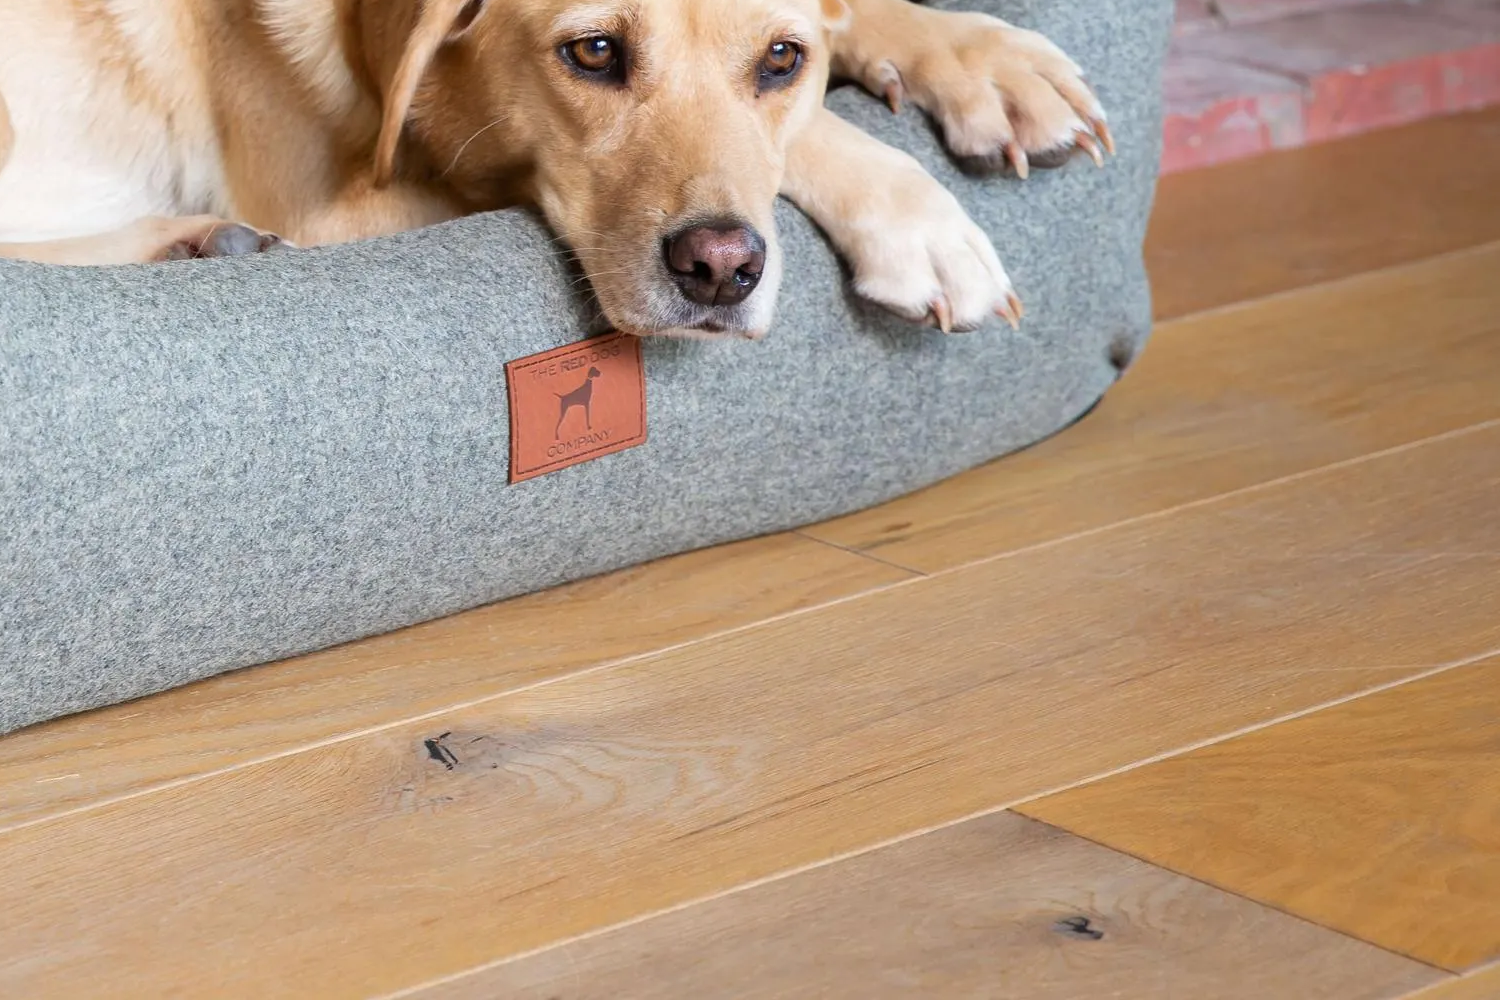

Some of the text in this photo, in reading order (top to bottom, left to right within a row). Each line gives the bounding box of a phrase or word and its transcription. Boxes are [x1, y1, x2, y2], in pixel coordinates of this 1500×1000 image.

[530, 345, 620, 379] THE RED DOG
[547, 430, 612, 458] COMPANY
